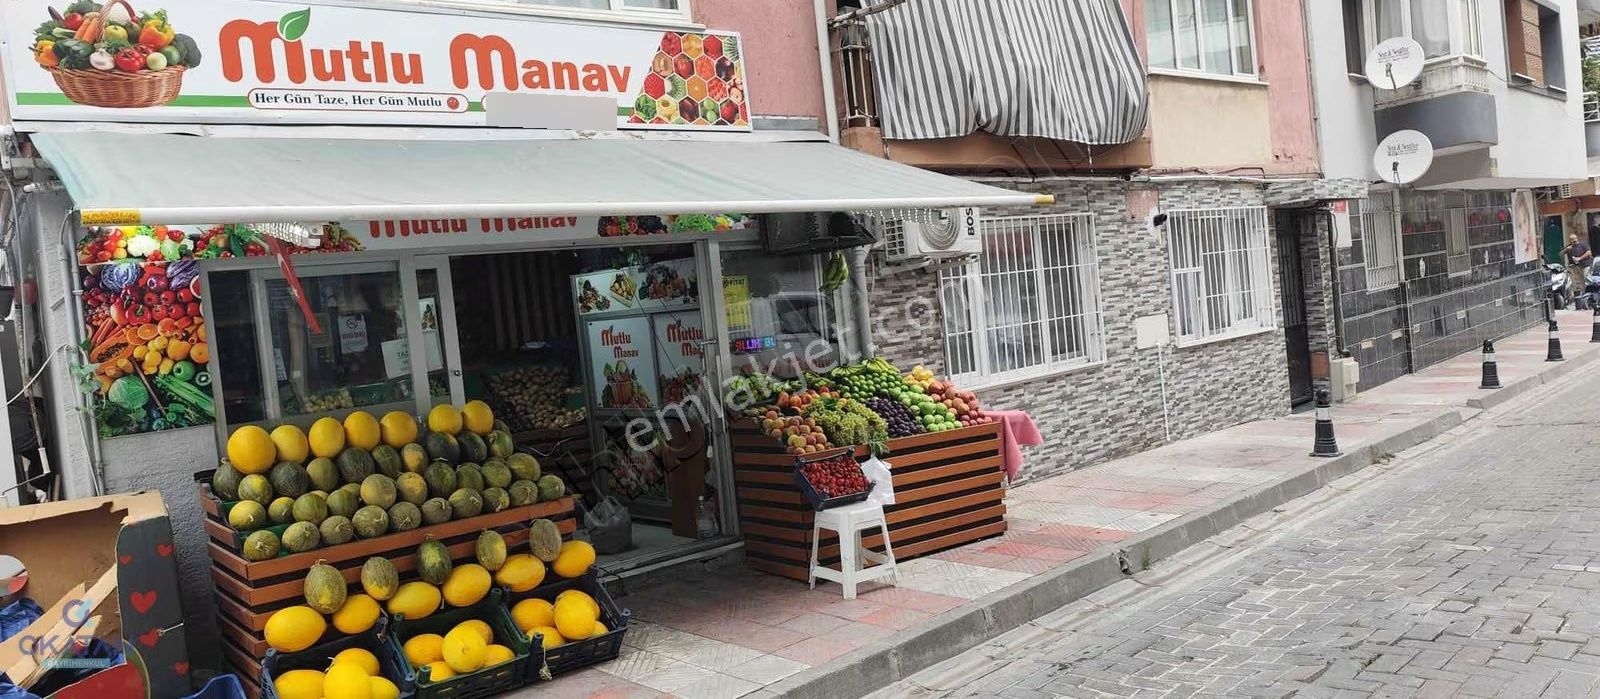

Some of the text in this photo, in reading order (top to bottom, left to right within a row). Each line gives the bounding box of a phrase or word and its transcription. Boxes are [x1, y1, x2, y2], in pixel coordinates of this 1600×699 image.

[218, 18, 631, 92] Mutlu Manav
[254, 93, 442, 107] Her Gün Taze, Her Gün Mutlu
[966, 207, 975, 236] BOS
[601, 329, 631, 346] Mutlu
[667, 323, 703, 342] Mutlu
[613, 346, 639, 358] Manav
